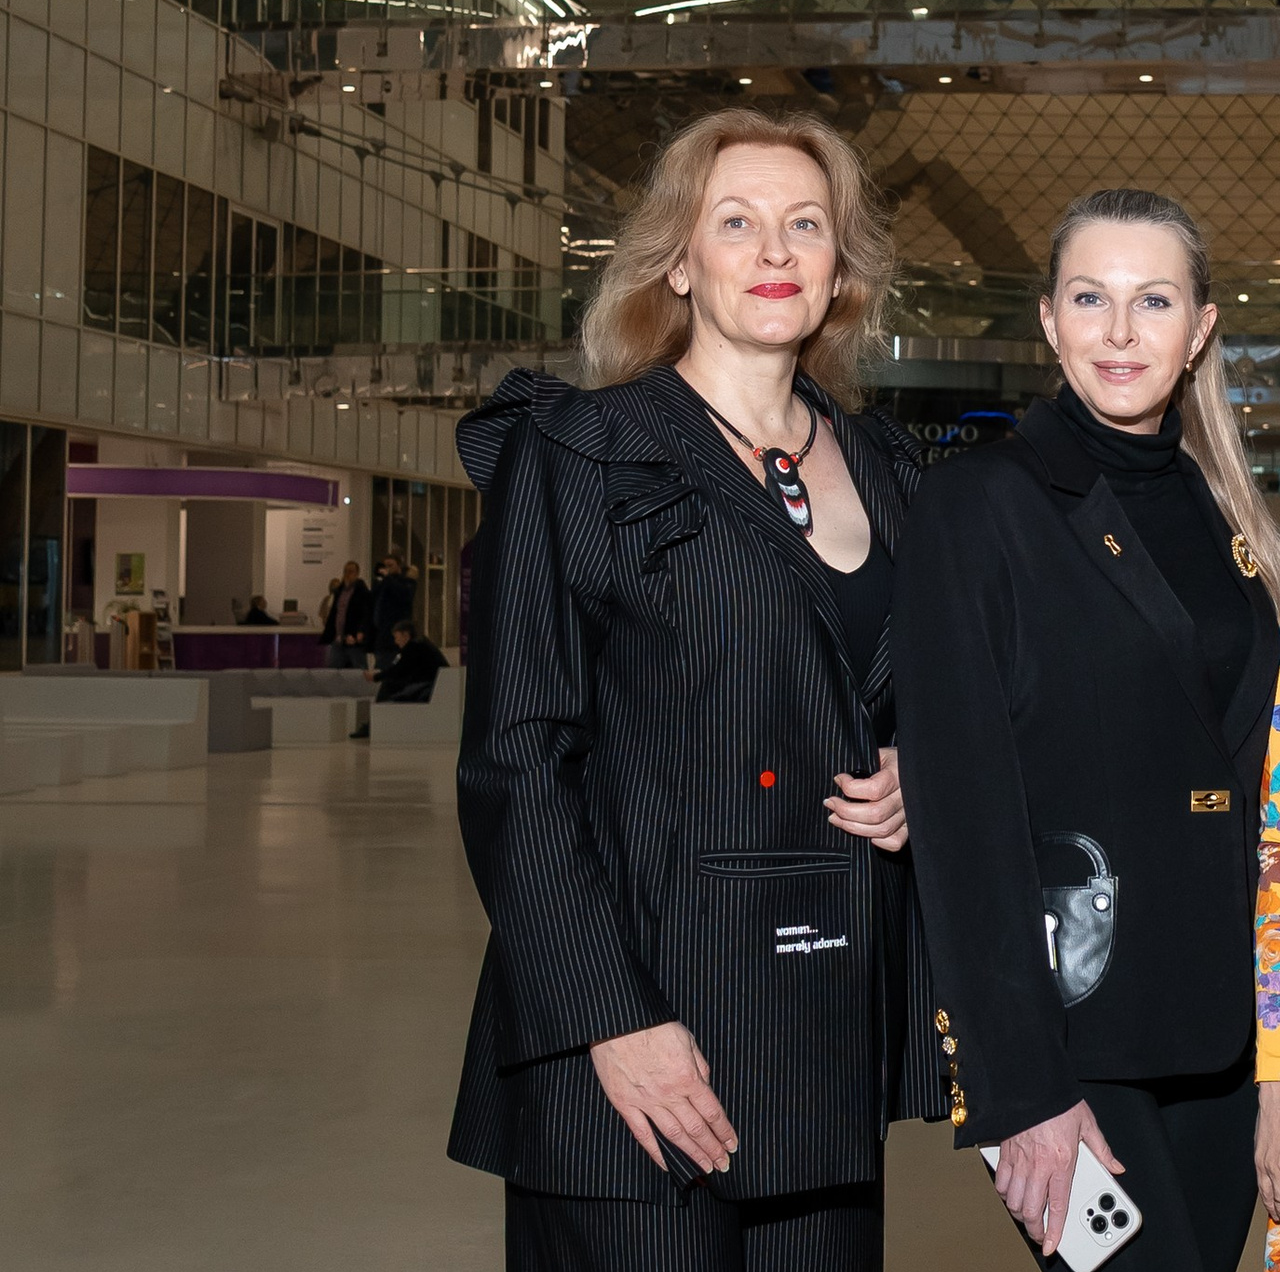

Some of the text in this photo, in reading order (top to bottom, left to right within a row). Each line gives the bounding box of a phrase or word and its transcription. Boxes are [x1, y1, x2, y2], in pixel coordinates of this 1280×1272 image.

[776, 924, 819, 937] women...
[776, 934, 849, 954] merely adored.
